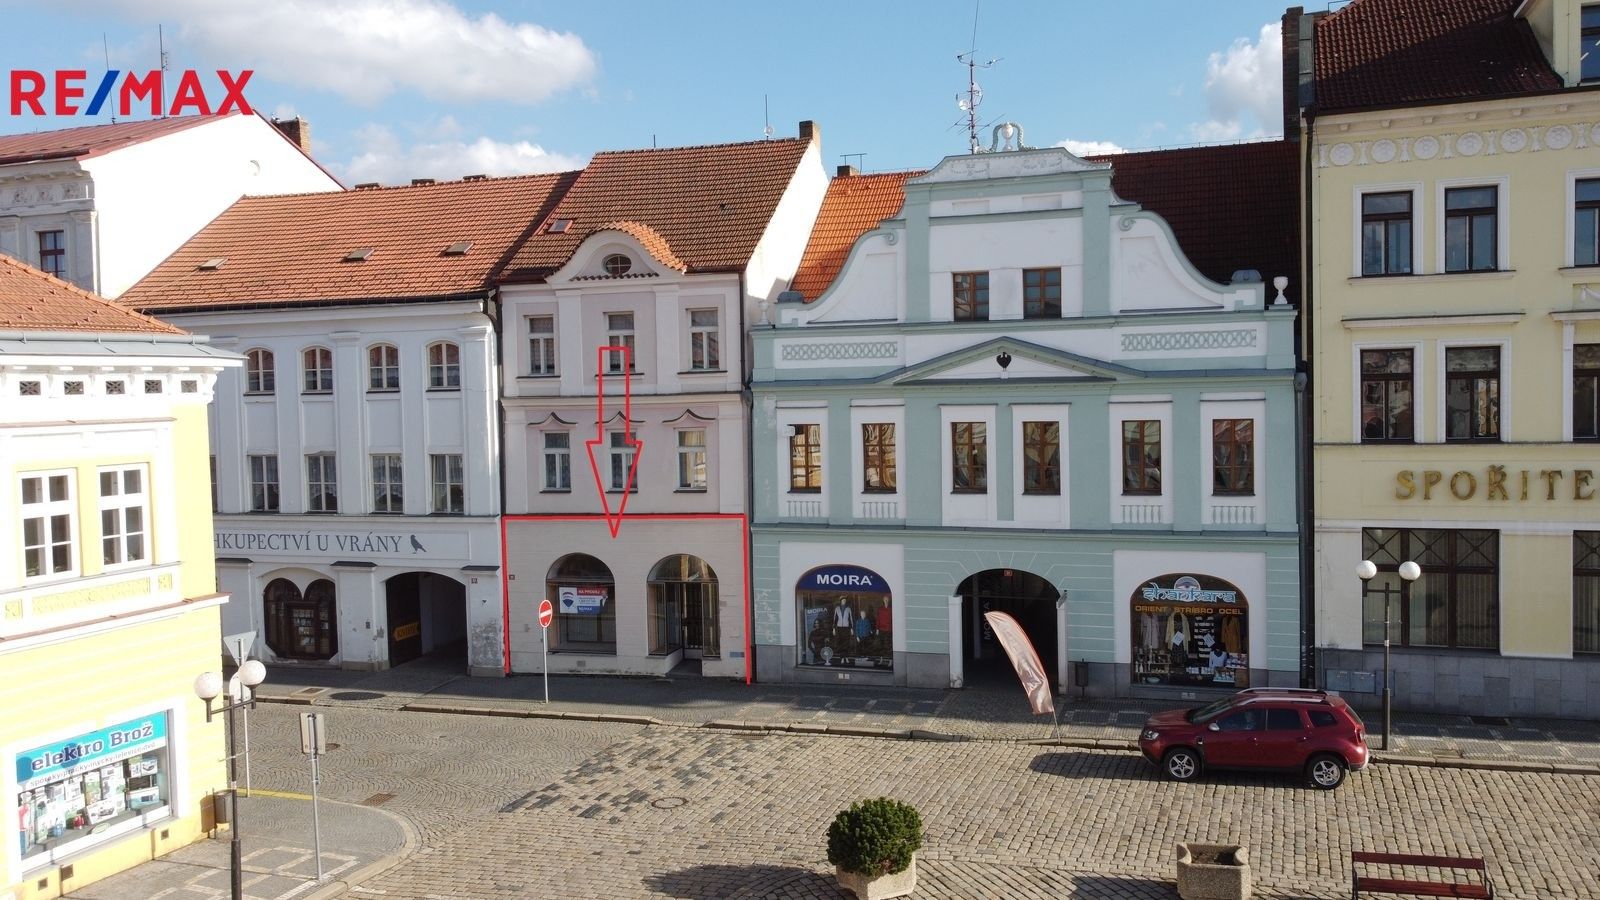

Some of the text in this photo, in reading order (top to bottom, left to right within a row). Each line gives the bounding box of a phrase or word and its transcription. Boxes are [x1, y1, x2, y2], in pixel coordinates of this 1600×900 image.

[1395, 464, 1597, 501] SPOŘITE
[317, 535, 330, 551] U
[336, 531, 403, 553] VRÁNY
[816, 574, 872, 585] MOIRA
[1135, 605, 1169, 613] ORIENT
[1218, 607, 1244, 615] OCEL
[31, 722, 153, 771] elektro Brož
